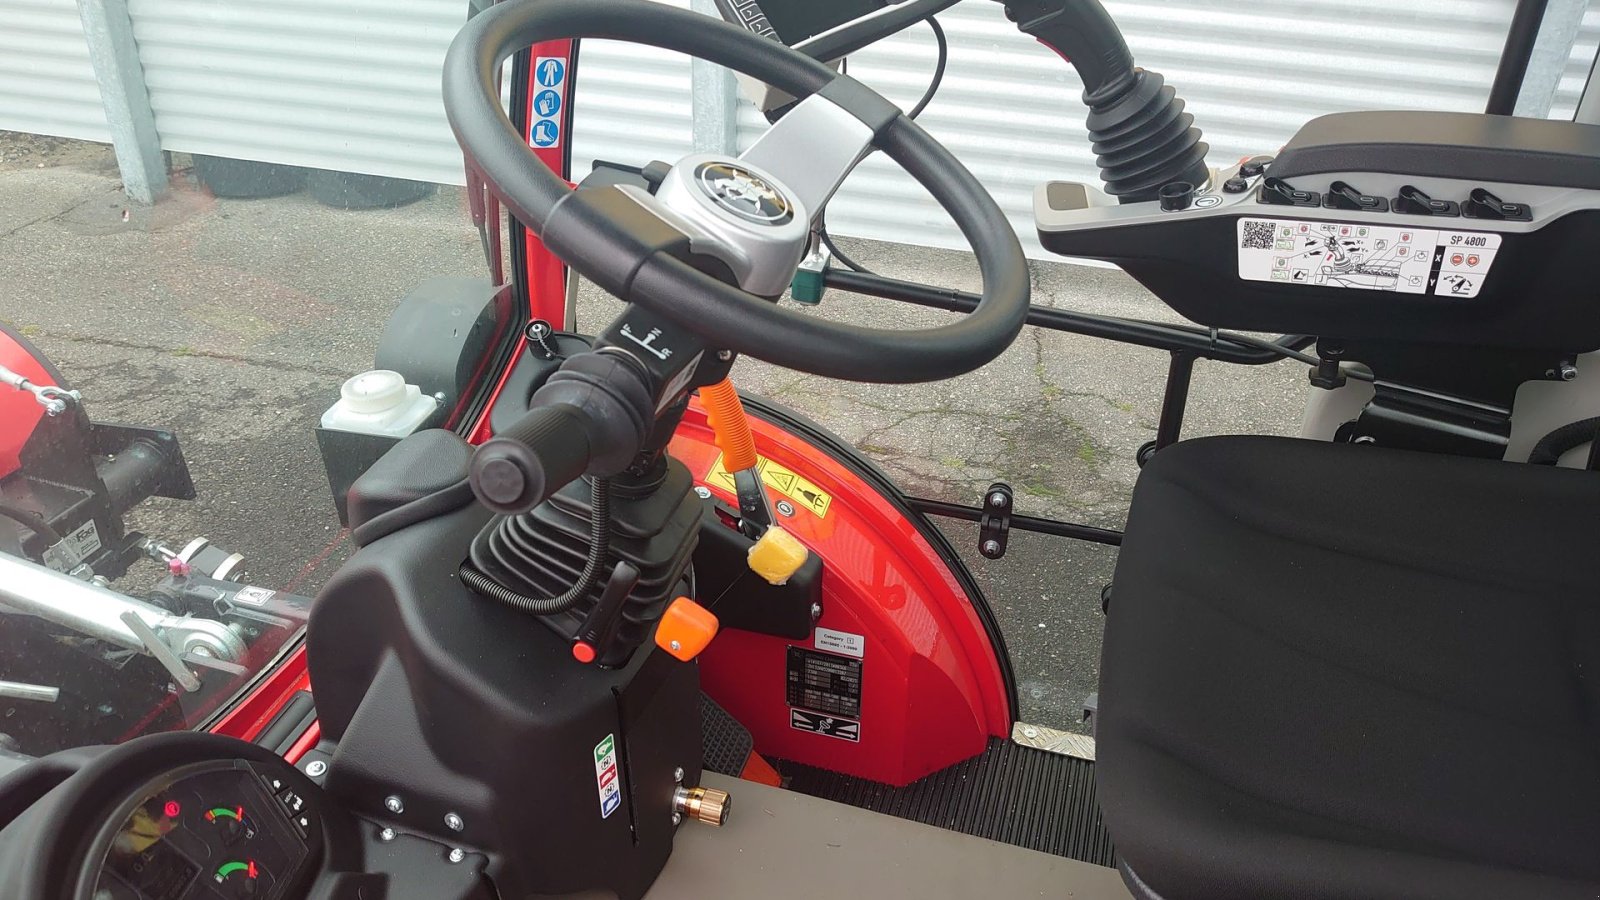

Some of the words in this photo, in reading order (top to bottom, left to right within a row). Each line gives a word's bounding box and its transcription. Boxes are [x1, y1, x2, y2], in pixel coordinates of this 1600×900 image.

[1450, 235, 1463, 245] SP
[1464, 236, 1487, 247] 4800
[1435, 254, 1441, 262] X
[1429, 279, 1436, 287] Y
[622, 323, 632, 333] F
[651, 327, 662, 337] N
[661, 347, 673, 357] R
[823, 633, 844, 642] Category
